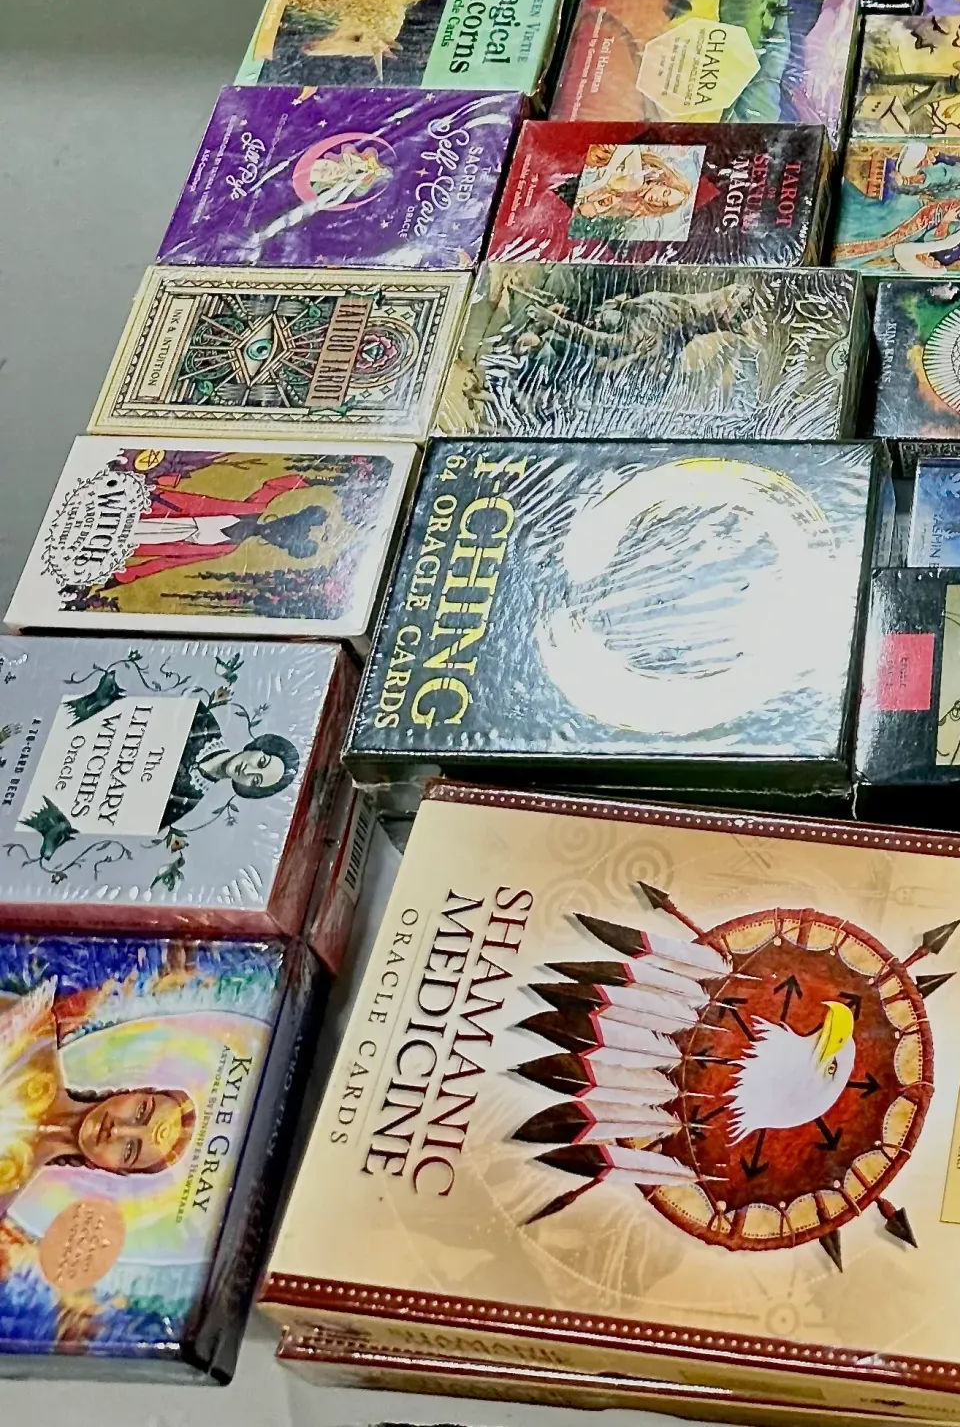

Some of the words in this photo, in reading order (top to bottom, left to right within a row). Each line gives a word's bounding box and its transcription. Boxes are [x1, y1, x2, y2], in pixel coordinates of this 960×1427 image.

[440, 15, 457, 48] Cards
[693, 28, 728, 106] CHAKRA
[413, 117, 471, 238] Self-Care
[457, 144, 484, 203] SACRED
[477, 165, 491, 182] THE
[721, 157, 752, 229] MAGIC
[738, 154, 769, 232] SEXUAL
[775, 161, 802, 228] TAROT
[399, 205, 416, 238] ORACLE
[148, 336, 173, 387] INTUITION
[325, 303, 369, 354] TATTOO
[312, 355, 353, 402] TAROT
[435, 454, 468, 481] 64
[83, 488, 127, 566] WITCH
[404, 493, 458, 612] ORACLE
[410, 455, 528, 730] I-CHING
[374, 623, 423, 730] CARDS
[2, 777, 18, 807] DECK
[55, 733, 87, 792] Oracle
[69, 711, 123, 820] WITCHES
[97, 704, 155, 827] LITERARY
[141, 746, 166, 784] The
[366, 905, 420, 1025] ORACLE
[361, 887, 486, 1178] MEDICINE
[413, 885, 535, 1199] SHAMANIC
[215, 1055, 253, 1126] KYLE
[328, 1038, 378, 1146] CARDS
[190, 1132, 231, 1215] GRAY
